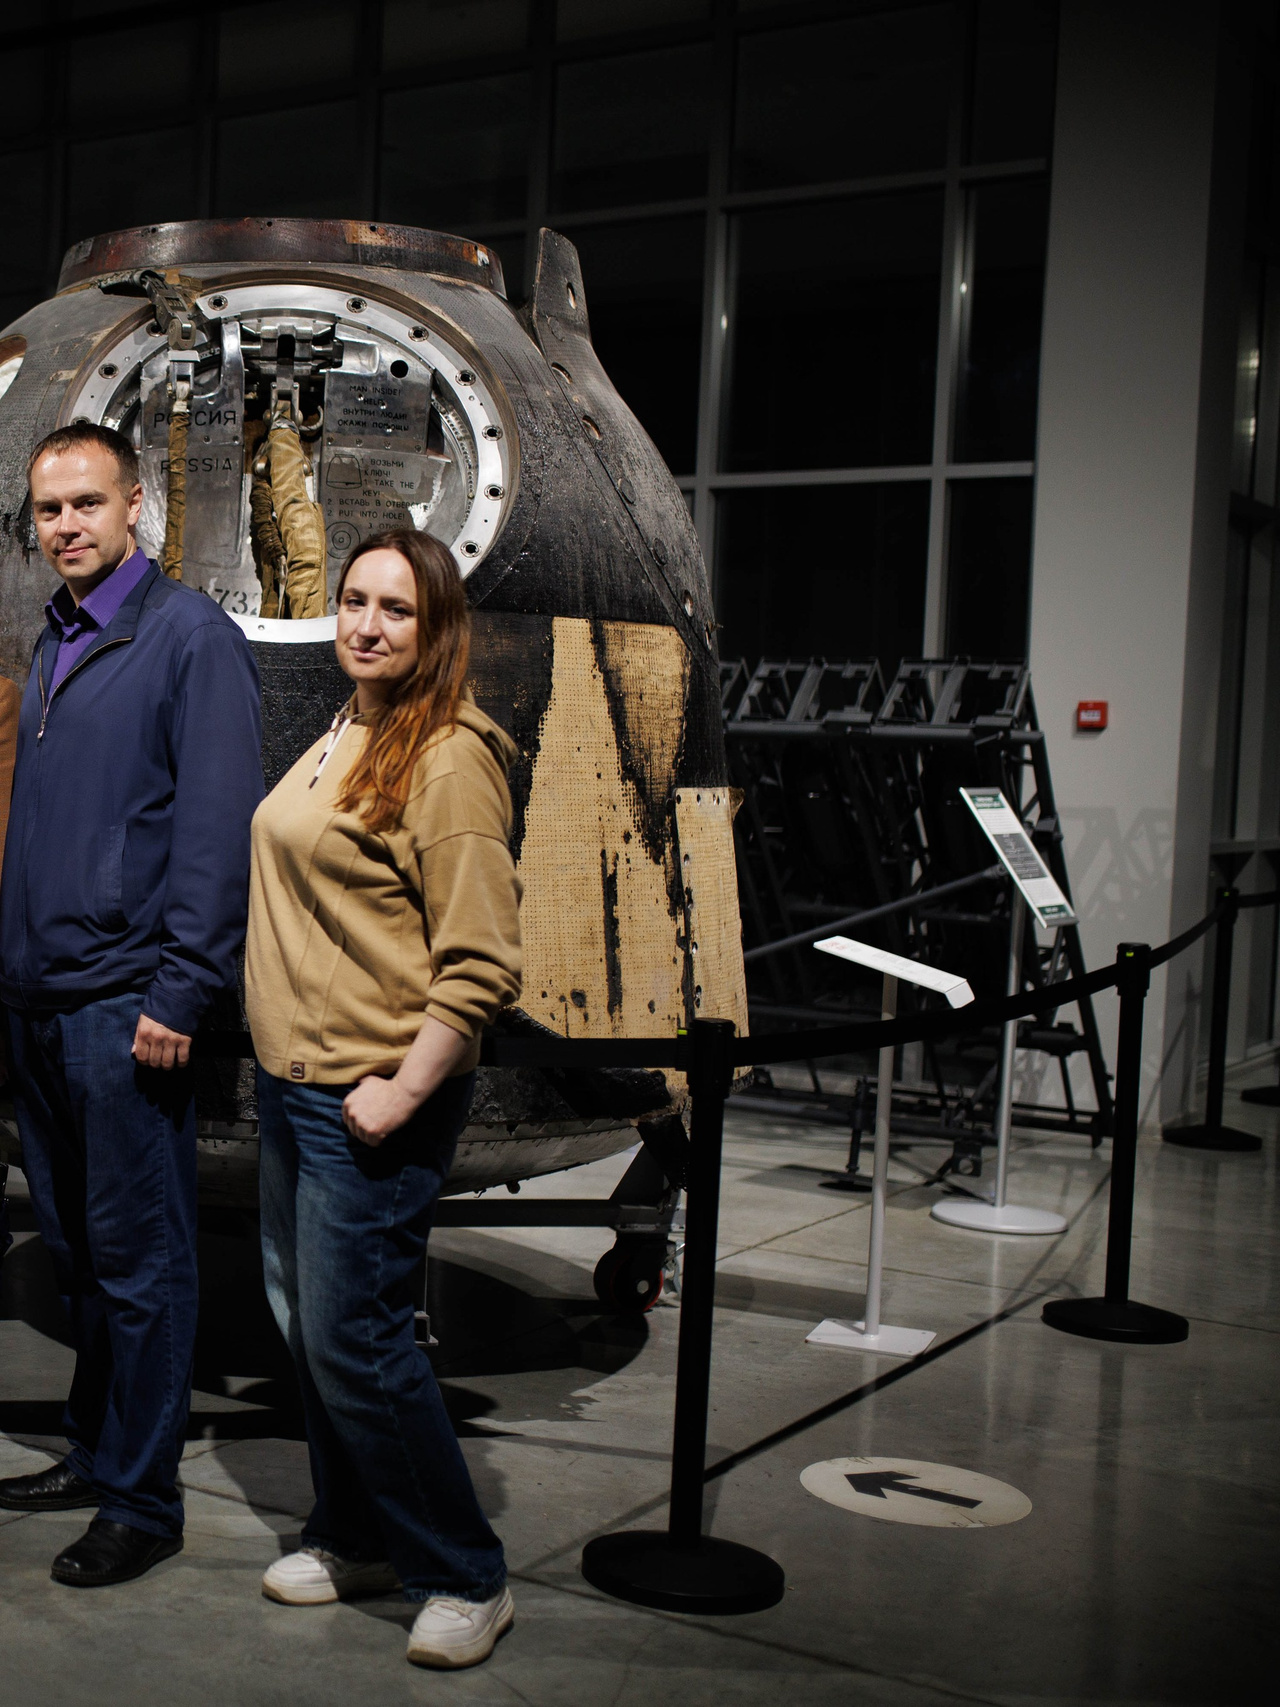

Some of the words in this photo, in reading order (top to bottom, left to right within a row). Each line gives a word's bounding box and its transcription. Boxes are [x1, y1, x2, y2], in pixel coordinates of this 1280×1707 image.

[372, 387, 401, 396] INSIDE!
[342, 407, 375, 417] ВНУТРИ
[153, 410, 236, 428] РСИЯ
[337, 419, 367, 428] ОКАЖИ
[160, 457, 232, 475] RSSIA
[370, 459, 404, 468] ВОЗЬМИ
[364, 469, 391, 477] КЛЮЧ!
[400, 481, 414, 489] THE
[339, 499, 370, 507] ВСТАВЬ
[360, 510, 378, 518] INTO
[382, 512, 405, 520] HOLE!
